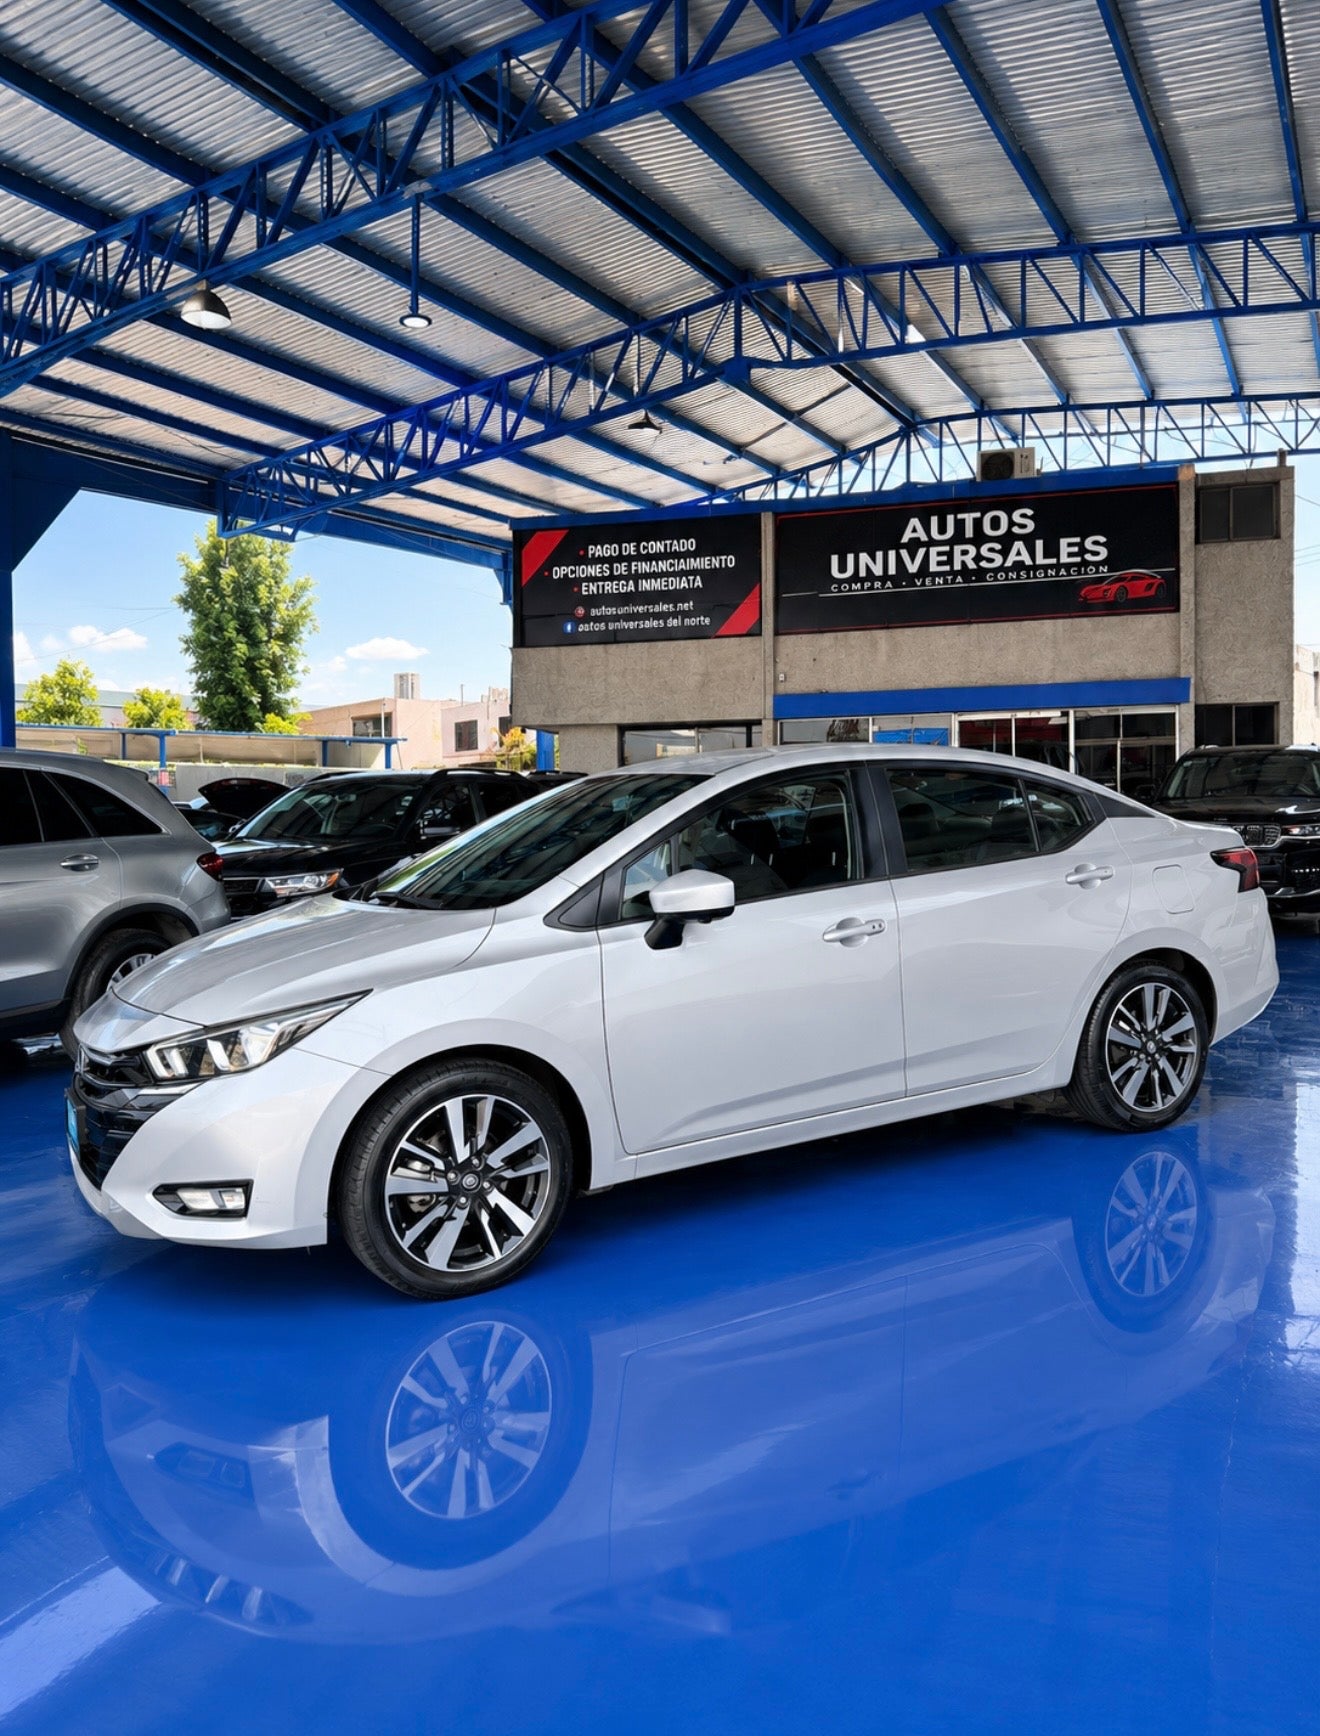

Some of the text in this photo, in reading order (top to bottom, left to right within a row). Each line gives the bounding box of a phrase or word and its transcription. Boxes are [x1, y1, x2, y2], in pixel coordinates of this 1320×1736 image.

[900, 507, 1036, 543] AUTOS
[588, 538, 696, 559] PAGO DE CONTADO
[829, 535, 1109, 579] UNIVERSALES
[552, 563, 610, 579] OPCIONES
[613, 561, 629, 576] DE
[581, 575, 703, 595] ENTREGA INMEDIATA
[830, 580, 894, 593] COMPRA
[914, 574, 963, 587] VENTA
[608, 616, 665, 631] universales
[666, 615, 681, 627] del
[684, 615, 711, 627] norte
